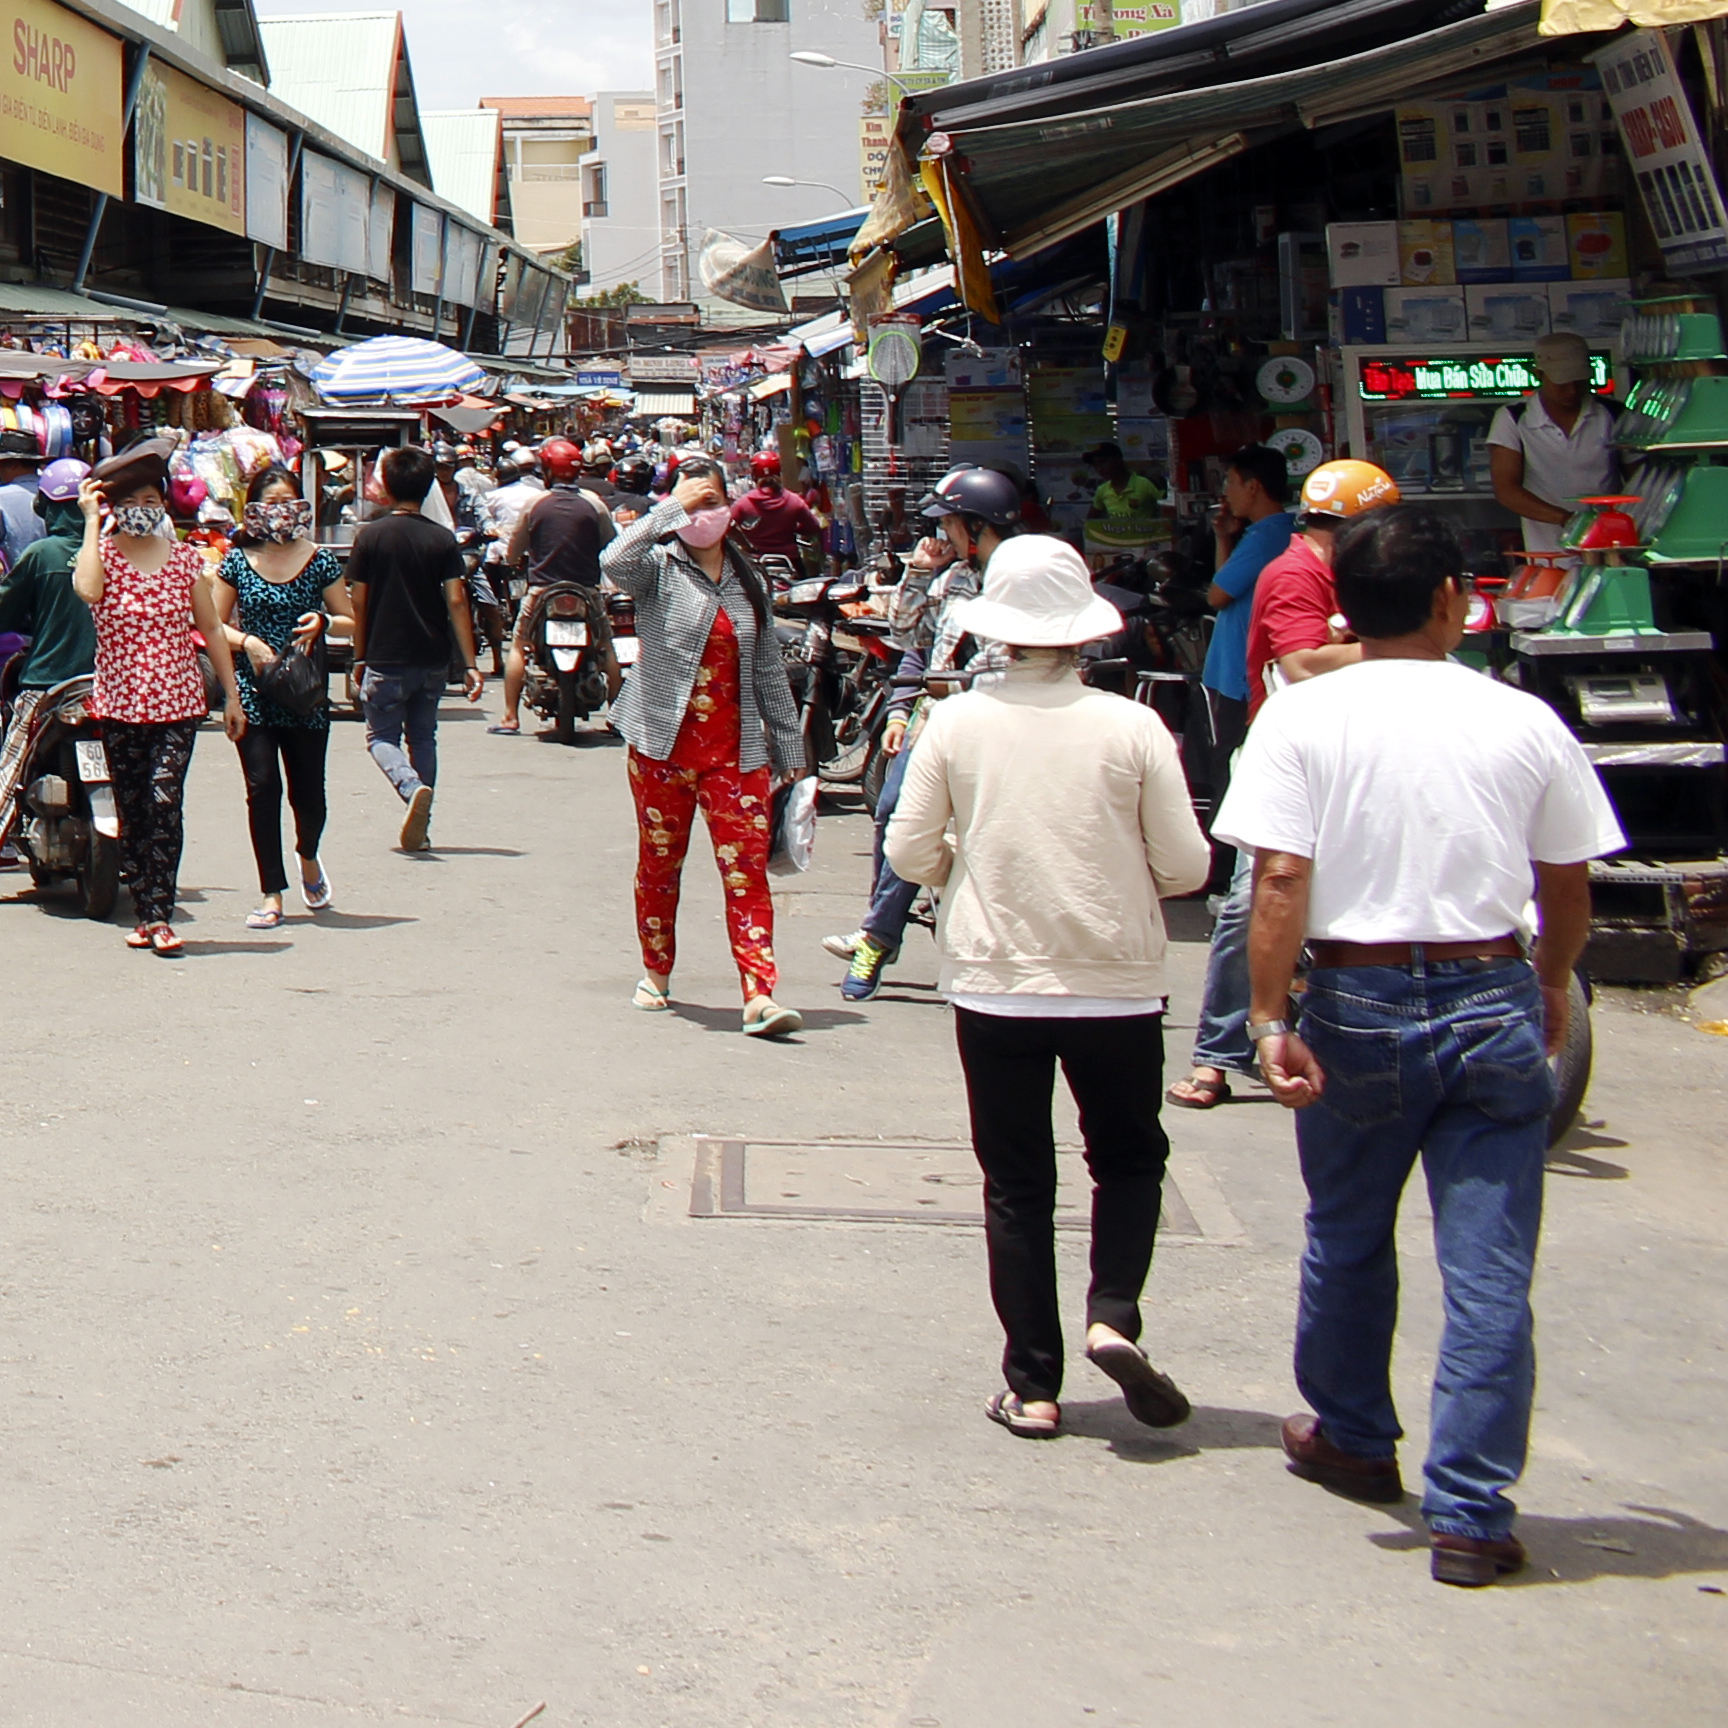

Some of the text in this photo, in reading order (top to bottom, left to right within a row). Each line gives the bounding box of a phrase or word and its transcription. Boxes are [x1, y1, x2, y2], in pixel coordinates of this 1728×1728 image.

[13, 17, 76, 94] SHARP
[1415, 366, 1441, 390] Mua
[1443, 364, 1469, 390] Bán
[1495, 364, 1529, 387] Chữa
